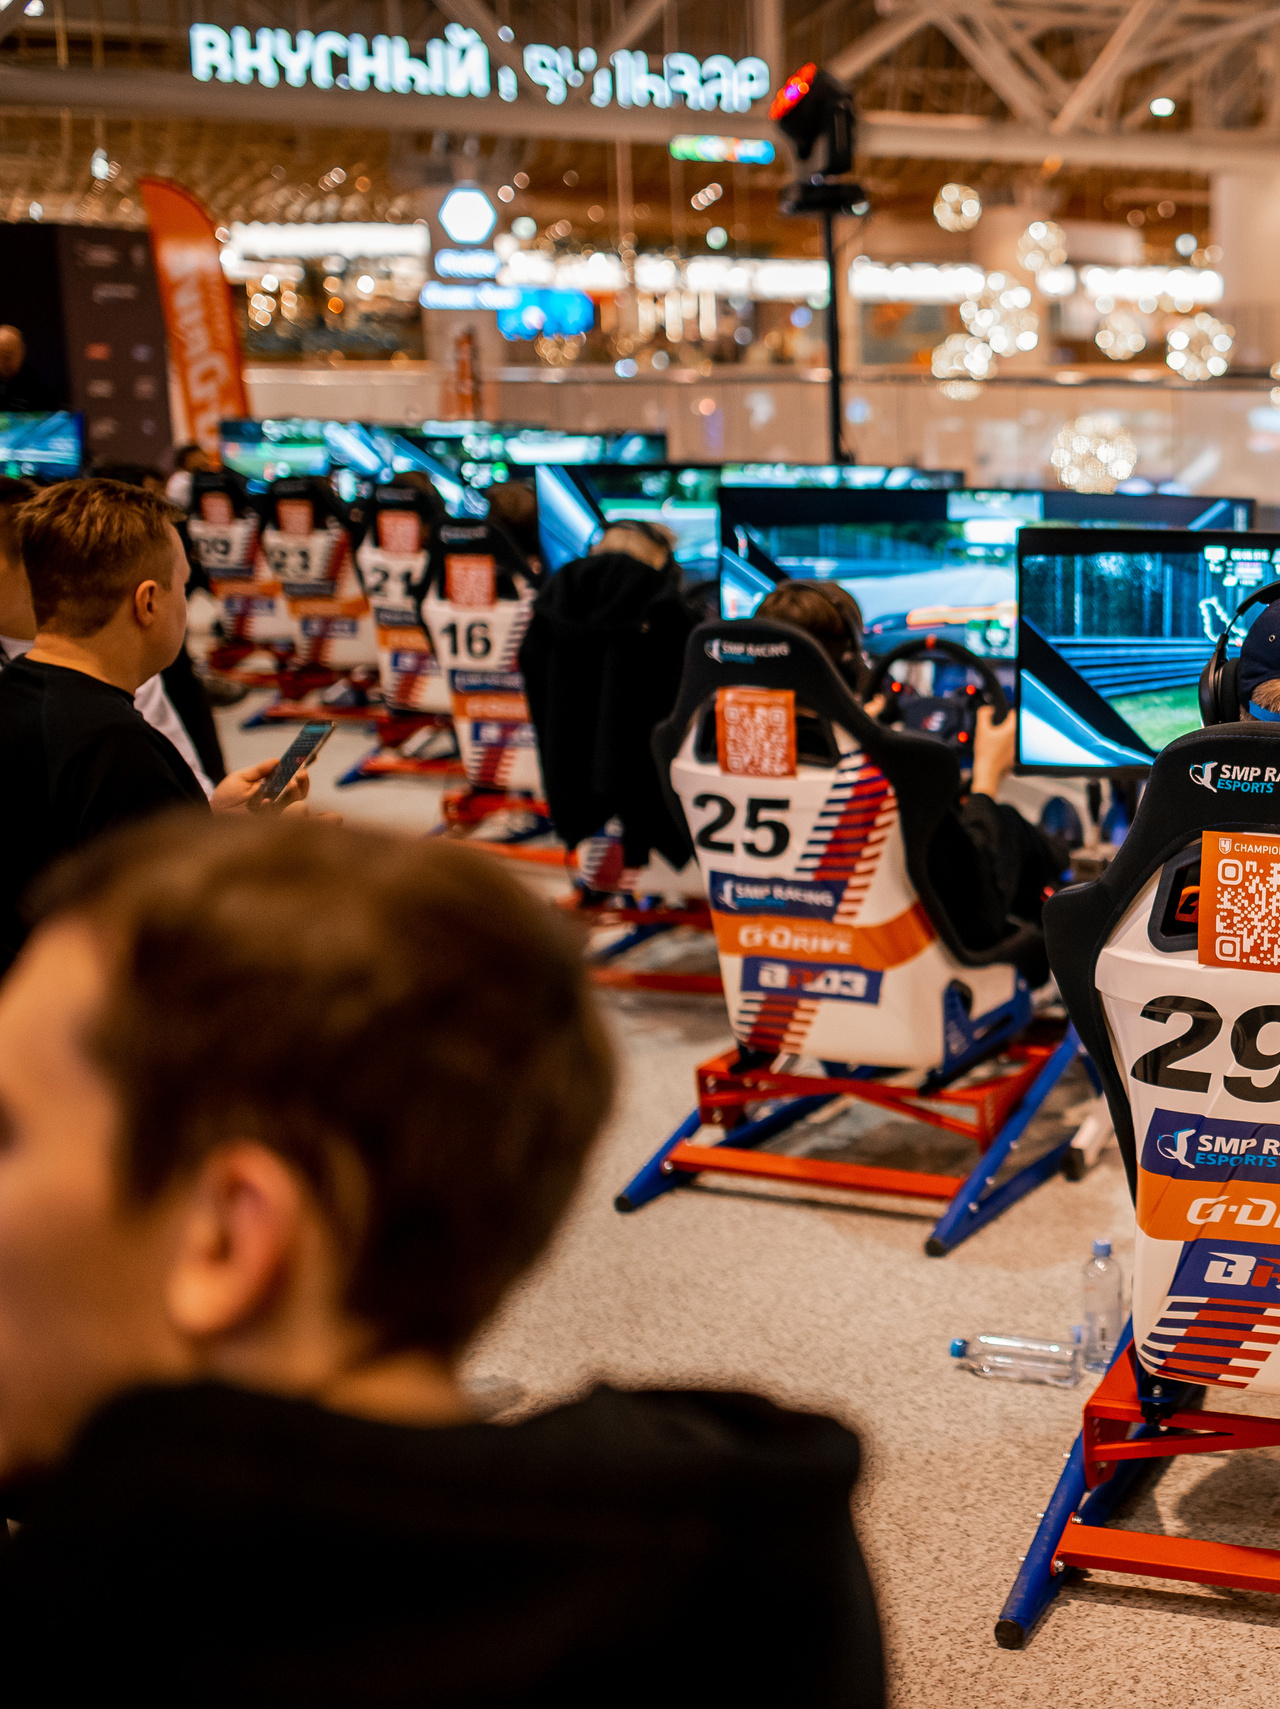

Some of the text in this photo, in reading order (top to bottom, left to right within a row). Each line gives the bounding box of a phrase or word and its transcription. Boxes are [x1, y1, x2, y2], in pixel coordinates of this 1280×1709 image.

[441, 621, 492, 658] 16
[1220, 764, 1262, 782] SMP
[1216, 778, 1275, 794] ESPORTS
[693, 793, 791, 858] 25
[1197, 1134, 1257, 1156] SMP
[1195, 1152, 1278, 1168] ESPORTS
